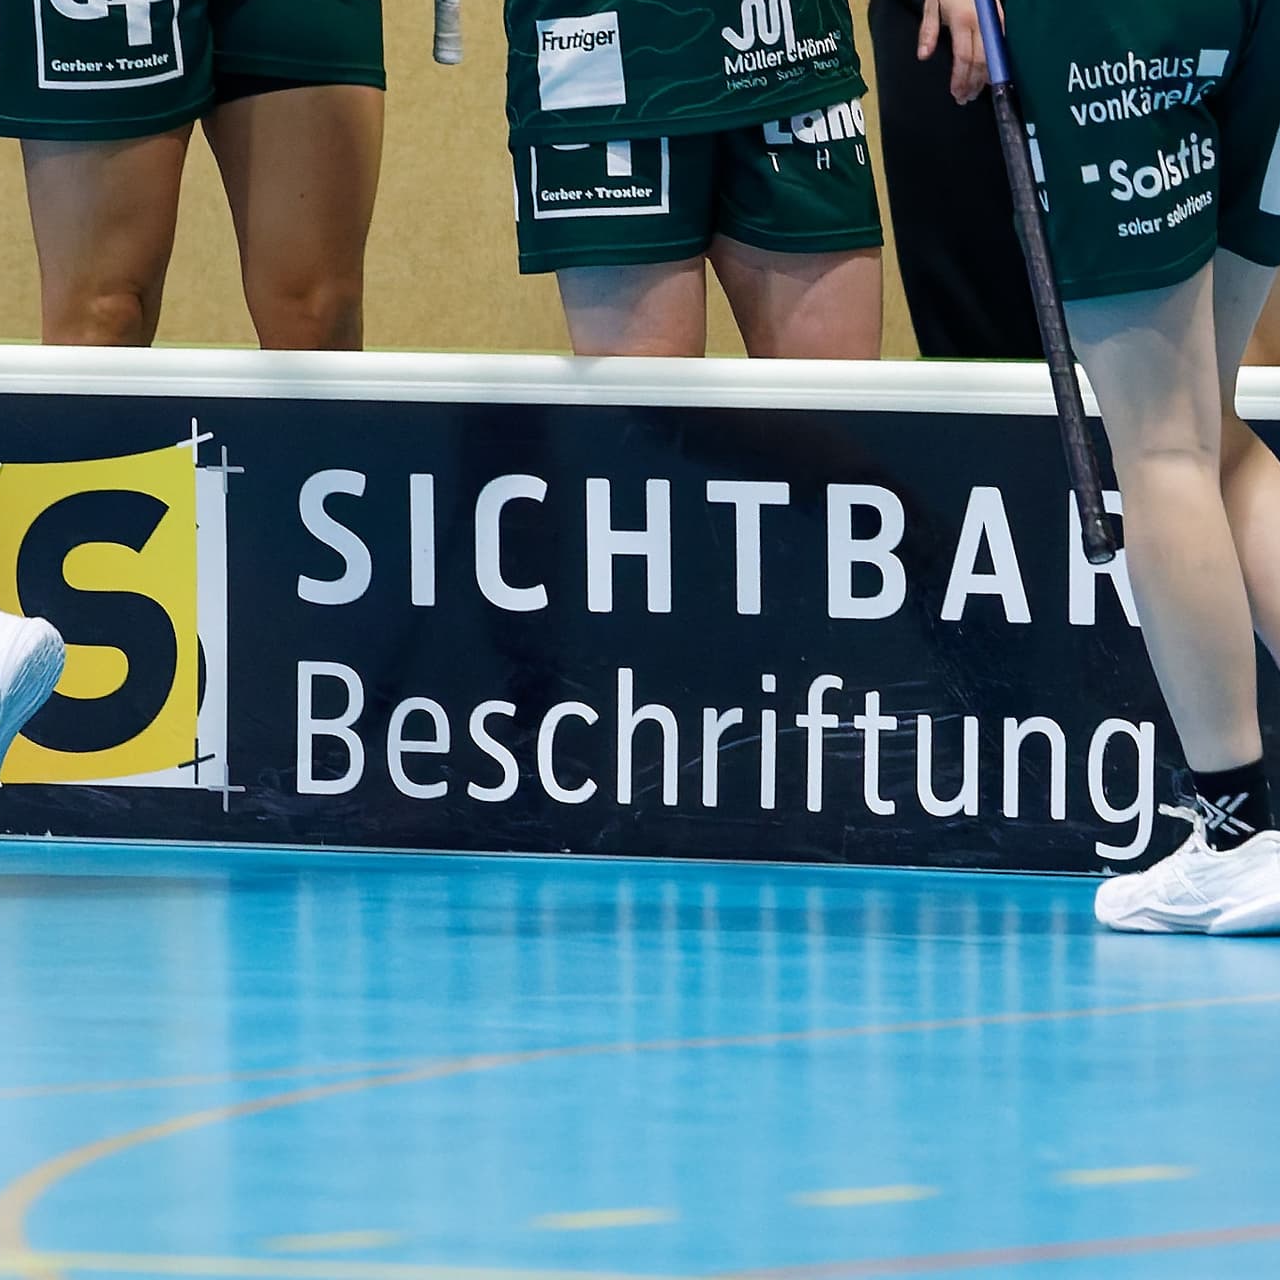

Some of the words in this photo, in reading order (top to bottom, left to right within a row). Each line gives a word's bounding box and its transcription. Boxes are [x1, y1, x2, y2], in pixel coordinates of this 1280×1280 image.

[541, 27, 616, 53] Frutiger
[52, 58, 103, 73] Gerber
[116, 53, 170, 71] Troxler
[724, 48, 785, 76] Müller
[1067, 51, 1195, 93] Autohaus
[1108, 131, 1216, 202] Solstis
[541, 188, 583, 202] Gerber
[595, 185, 653, 200] Troxler
[1117, 214, 1163, 238] solar
[1166, 191, 1213, 228] solutions
[294, 657, 1157, 861] Beschriftung
